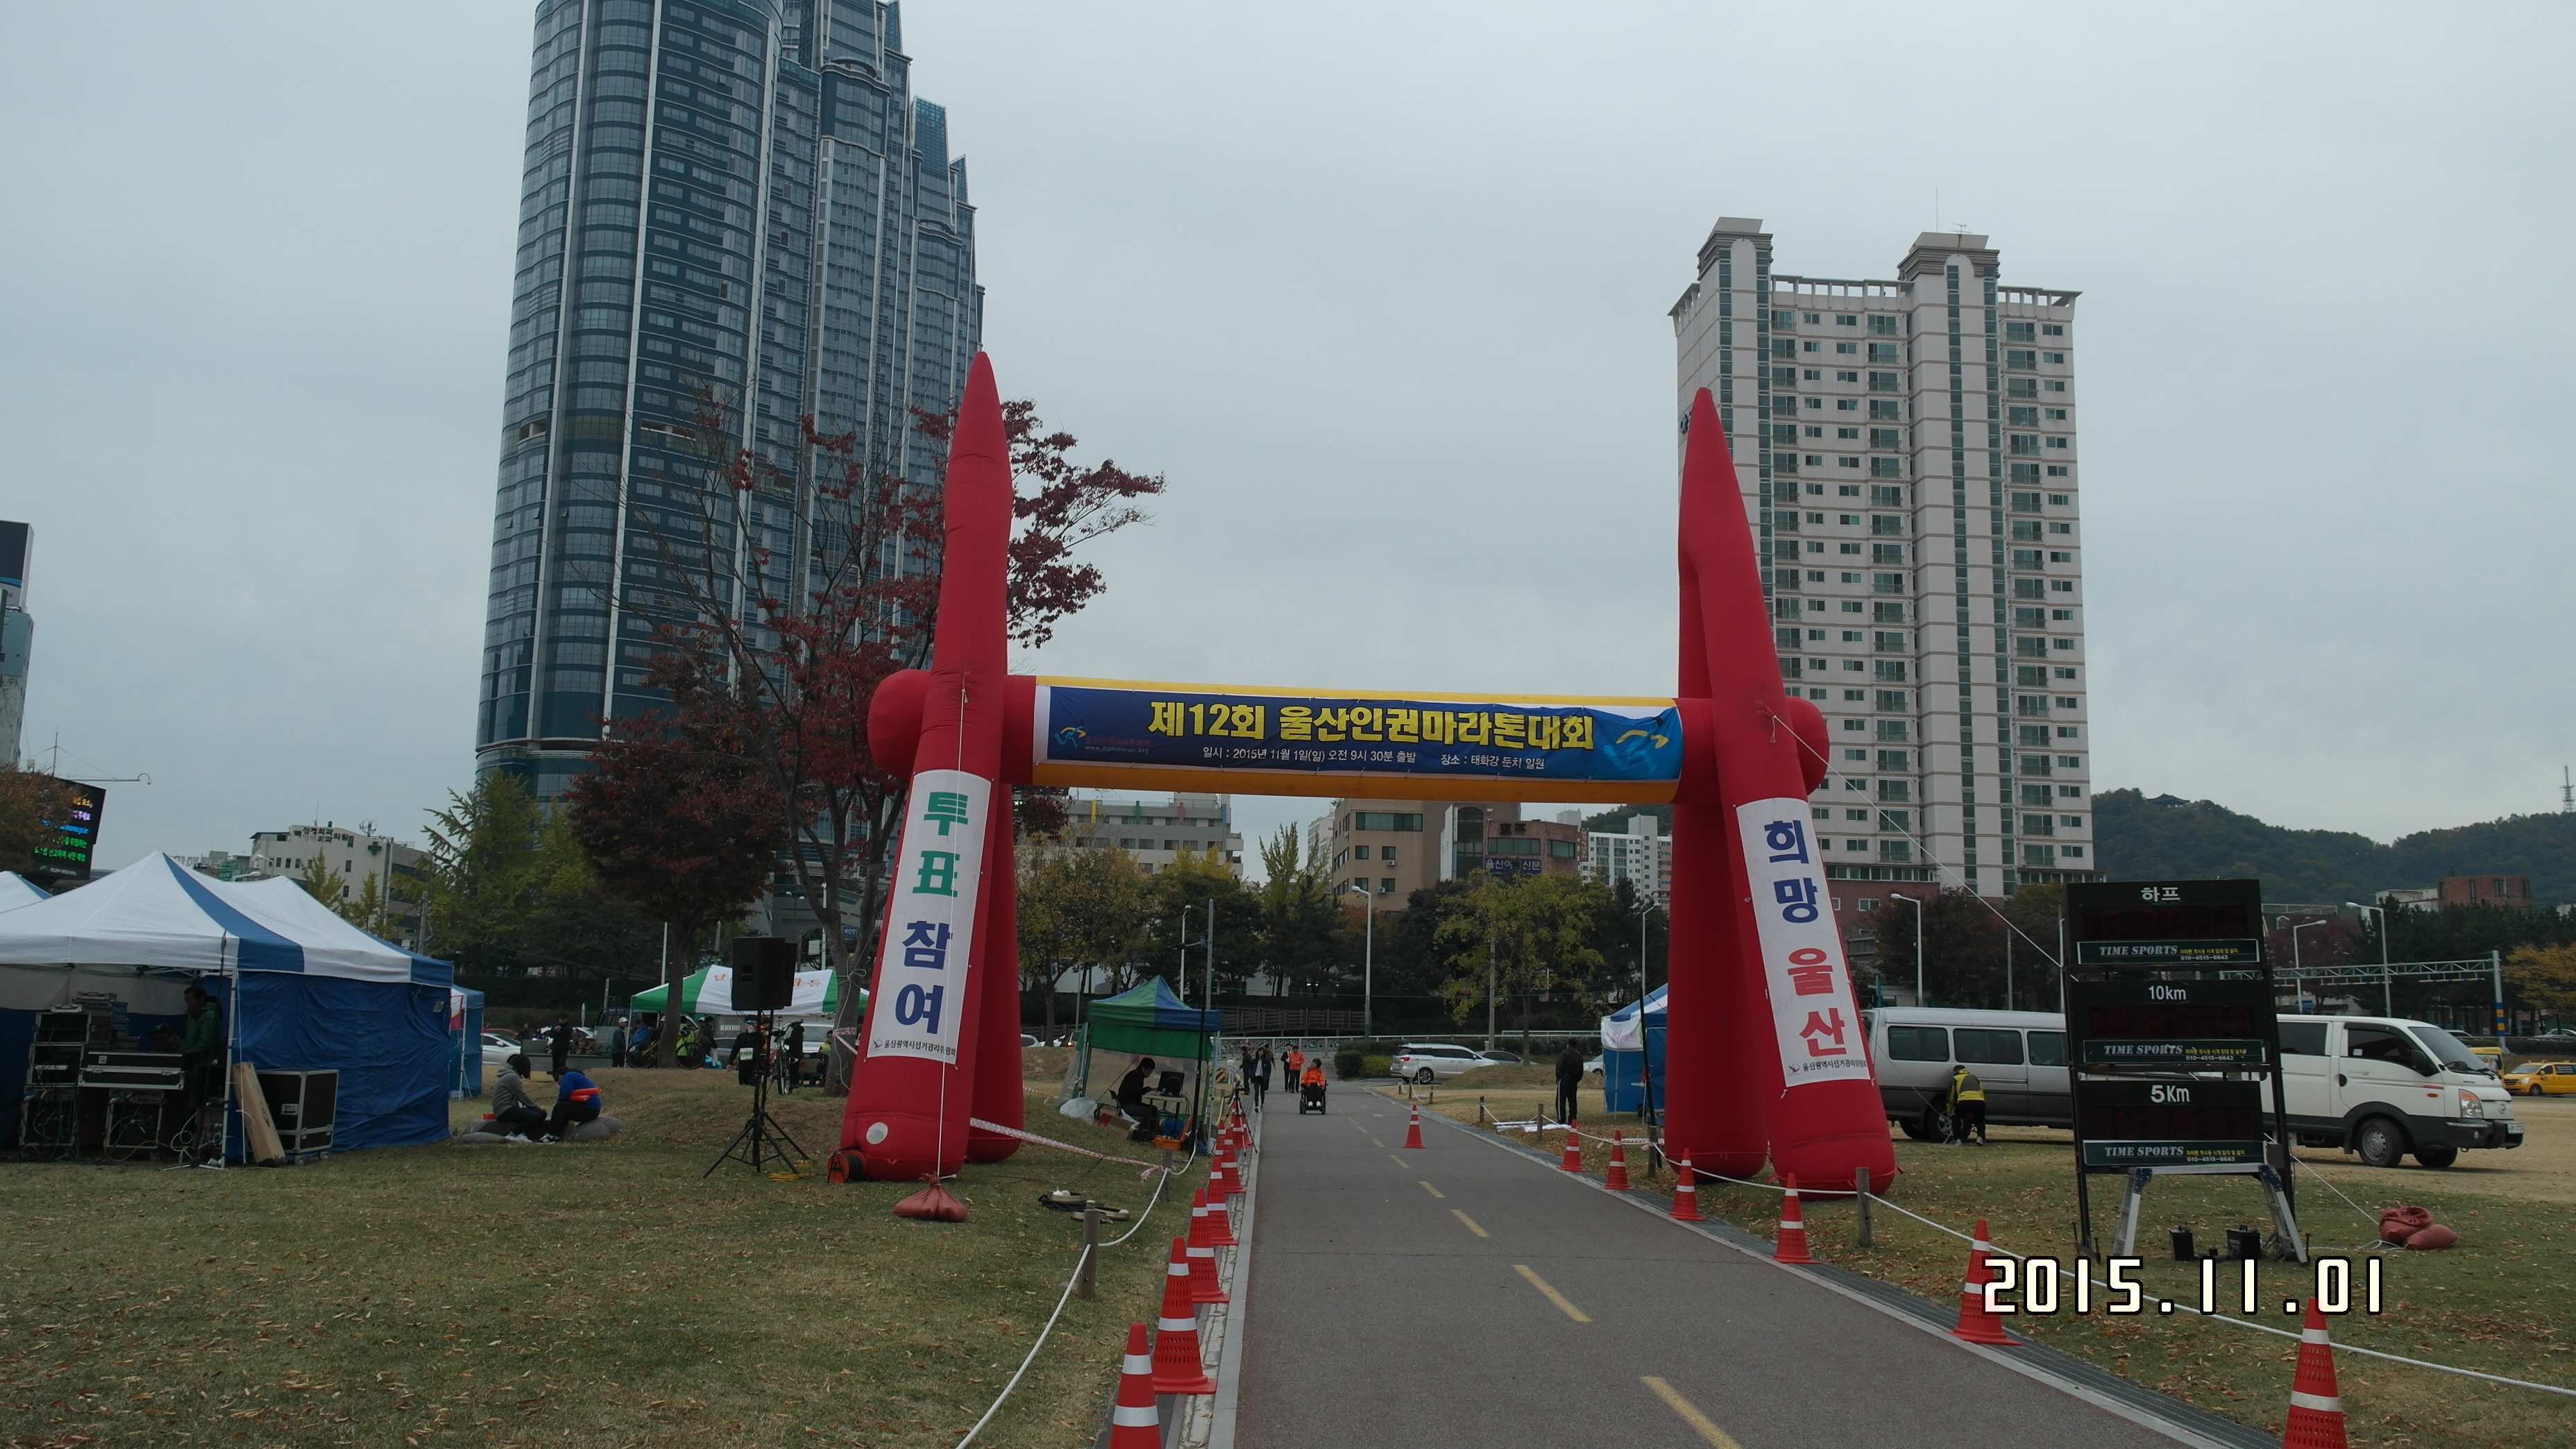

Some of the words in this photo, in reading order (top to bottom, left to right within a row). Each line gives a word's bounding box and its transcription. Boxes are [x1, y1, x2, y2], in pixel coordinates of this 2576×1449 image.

[1147, 701, 1265, 740] 제12회
[1279, 706, 1594, 750] 울산인권마라톤대회
[1085, 745, 1149, 754] www.humanrun.org
[1203, 747, 1223, 759] 일시
[1232, 748, 1267, 760] 2015년
[1271, 749, 1291, 761] 11월
[1294, 749, 1325, 762] 1일(일)
[1327, 750, 1348, 761] 오전
[1350, 750, 1367, 761] 9시
[1370, 751, 1393, 762] 30분
[1396, 751, 1416, 763] 출발
[1441, 754, 1461, 765] 장소
[1471, 754, 1499, 767] 태화강
[1502, 756, 1522, 769] 둔치
[1525, 757, 1545, 770] 일원
[912, 791, 969, 898] 투표
[1486, 858, 1541, 871] 울산여신문
[1763, 820, 1819, 924] 희망
[2140, 886, 2181, 902] 하프
[2100, 946, 2129, 956] TIME
[2132, 945, 2178, 956] SPORTS
[895, 920, 954, 1035] 참여
[2148, 985, 2187, 1001] 10km
[1787, 947, 1847, 1058] 울산
[884, 1040, 956, 1057] 울산광역시선거관리위원회
[2104, 1045, 2133, 1055] TIME
[2135, 1044, 2183, 1055] SPORTS
[2105, 1146, 2134, 1156] TIME
[2136, 1146, 2184, 1156] SPORTS
